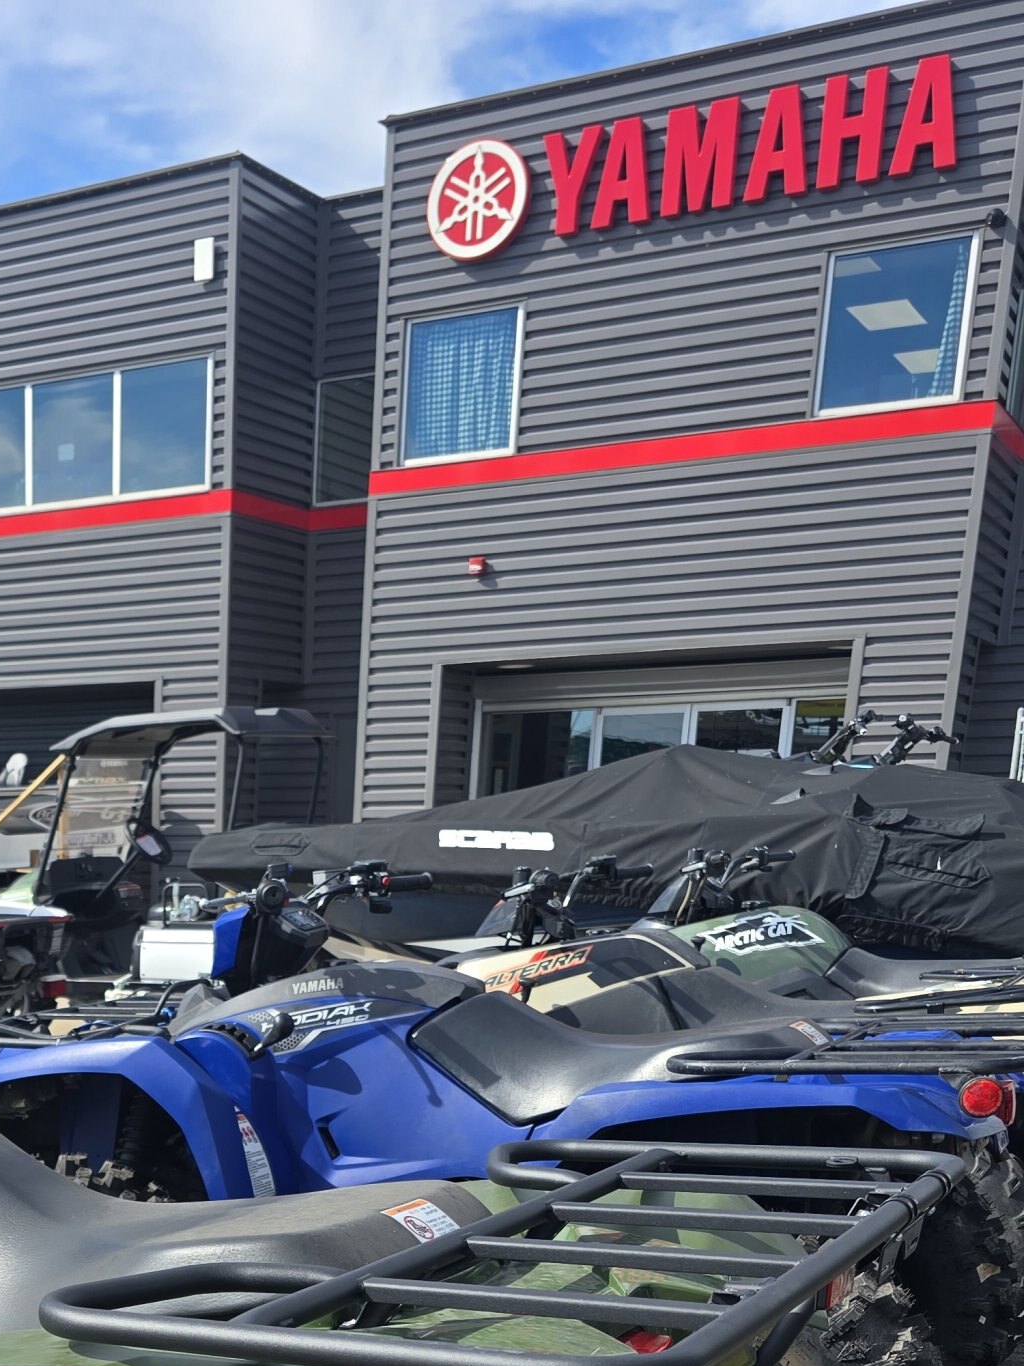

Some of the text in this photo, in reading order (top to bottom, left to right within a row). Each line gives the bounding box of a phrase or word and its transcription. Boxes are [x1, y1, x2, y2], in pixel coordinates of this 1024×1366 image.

[543, 53, 957, 237] YAMAHA
[714, 922, 794, 952] ARCTIC CAT
[291, 977, 344, 995] YAMAHA
[484, 948, 590, 989] ALTERRA
